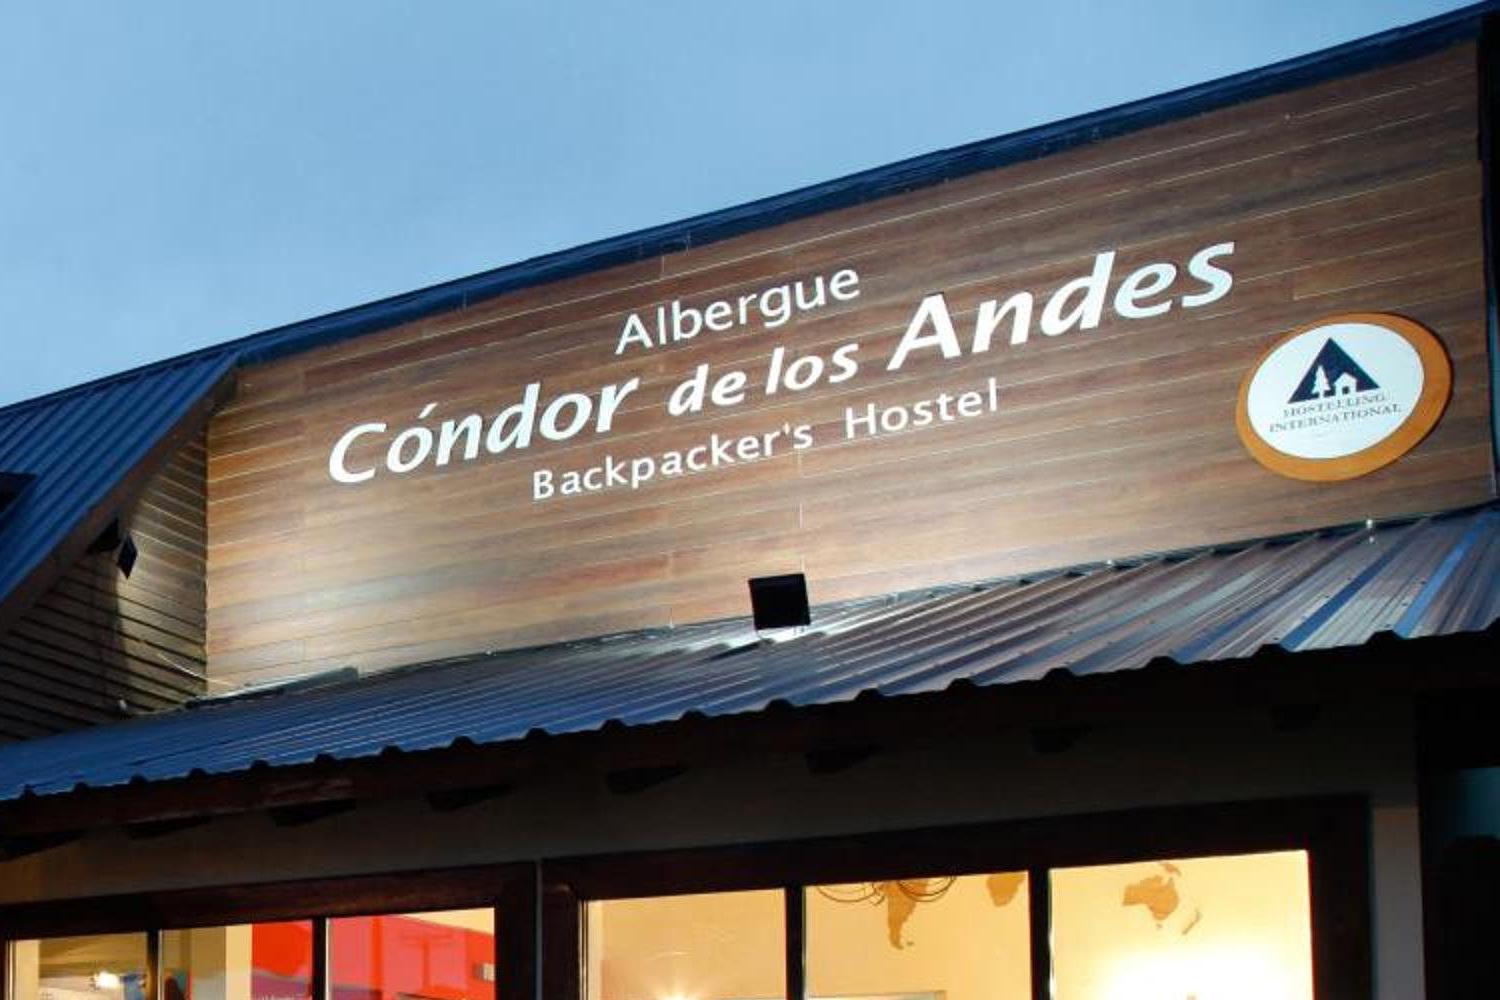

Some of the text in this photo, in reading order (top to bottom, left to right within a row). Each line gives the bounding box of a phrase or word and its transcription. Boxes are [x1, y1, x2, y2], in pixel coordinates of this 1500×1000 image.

[615, 268, 861, 355] Albergue
[328, 241, 1235, 484] Cóndor de los Andes
[1283, 393, 1387, 418] HOSTELLING
[532, 378, 998, 500] Backpacker's Hostel
[1268, 403, 1403, 433] INTERNATIONAL
